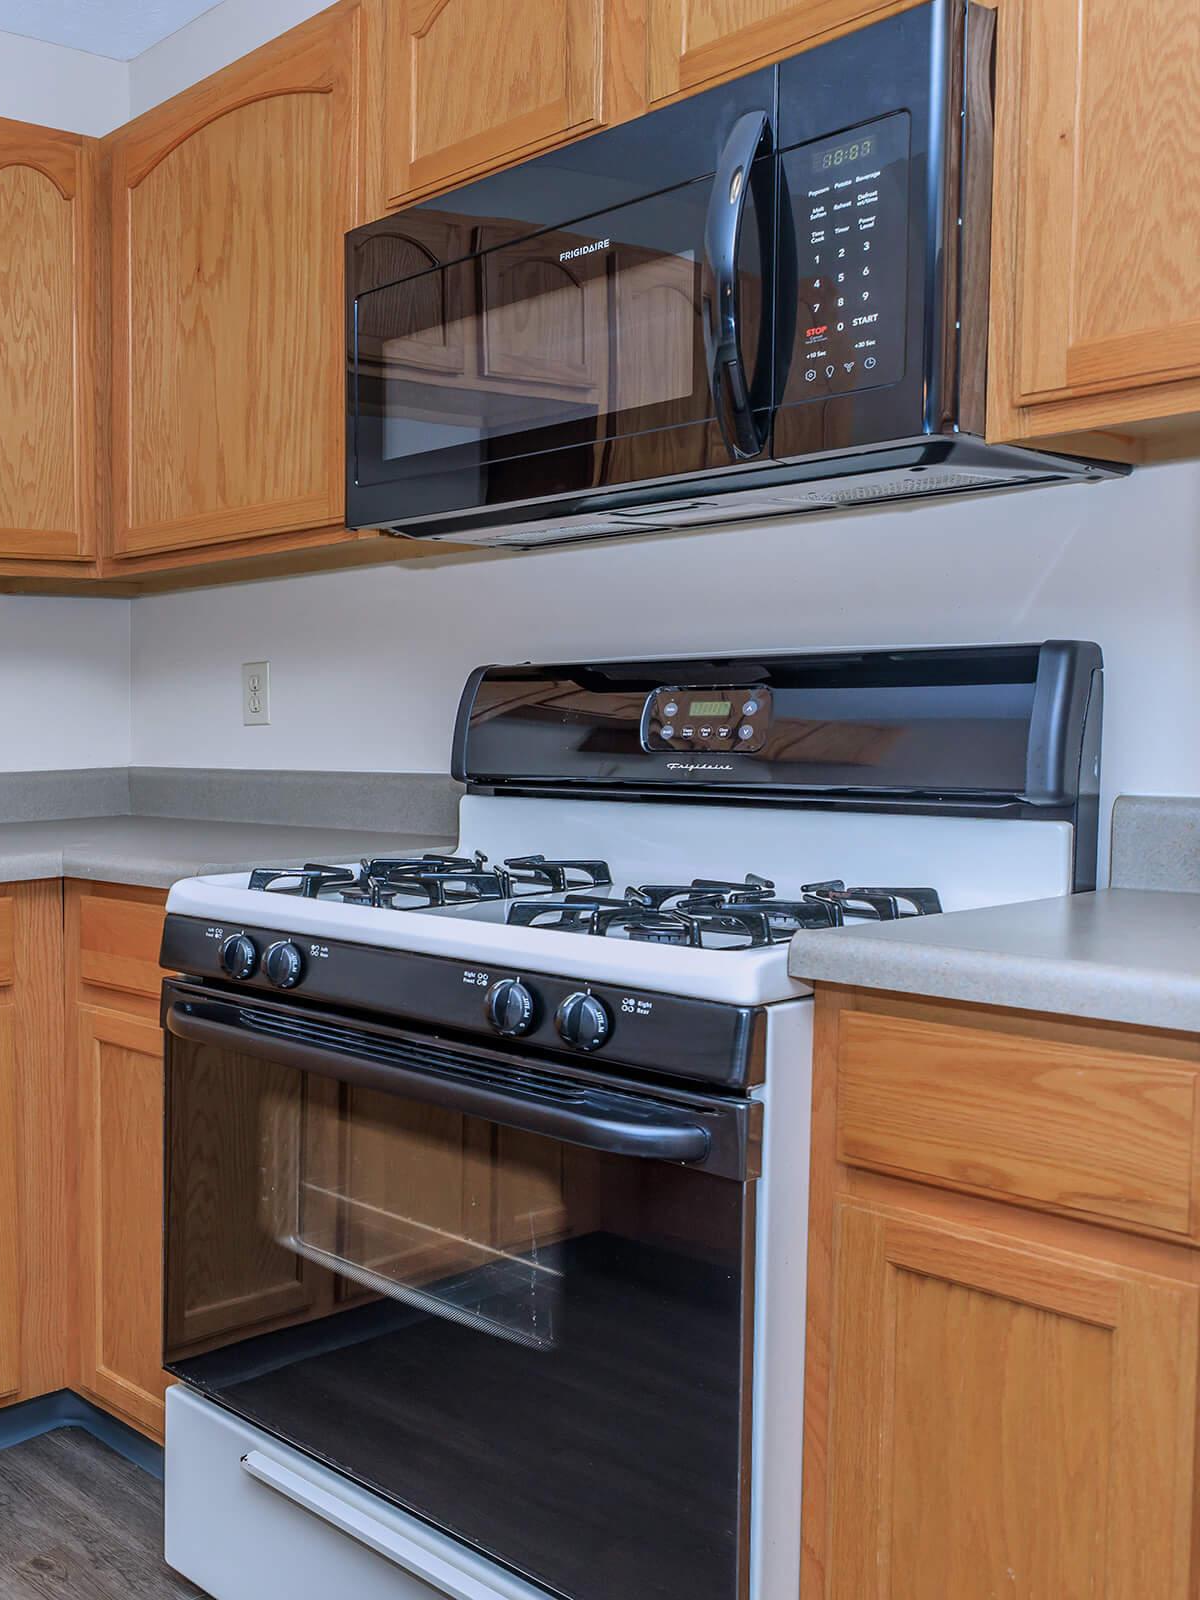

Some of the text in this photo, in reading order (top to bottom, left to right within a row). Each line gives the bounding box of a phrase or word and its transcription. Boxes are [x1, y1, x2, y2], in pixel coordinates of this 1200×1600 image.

[559, 238, 610, 262] FRIGIDAIRE
[863, 241, 870, 251] 3
[838, 248, 845, 258] 2
[814, 254, 820, 264] 1
[862, 266, 870, 276] 6
[838, 272, 845, 282] 5
[813, 279, 821, 288] 4
[862, 291, 869, 301] 9
[837, 297, 844, 307] 8
[813, 303, 820, 313] 7
[852, 313, 879, 326] START
[806, 326, 828, 336] STOP
[836, 322, 844, 331] 0
[666, 762, 733, 772] Frigidaire
[637, 1000, 653, 1010] Right
[636, 1007, 651, 1016] Rear
